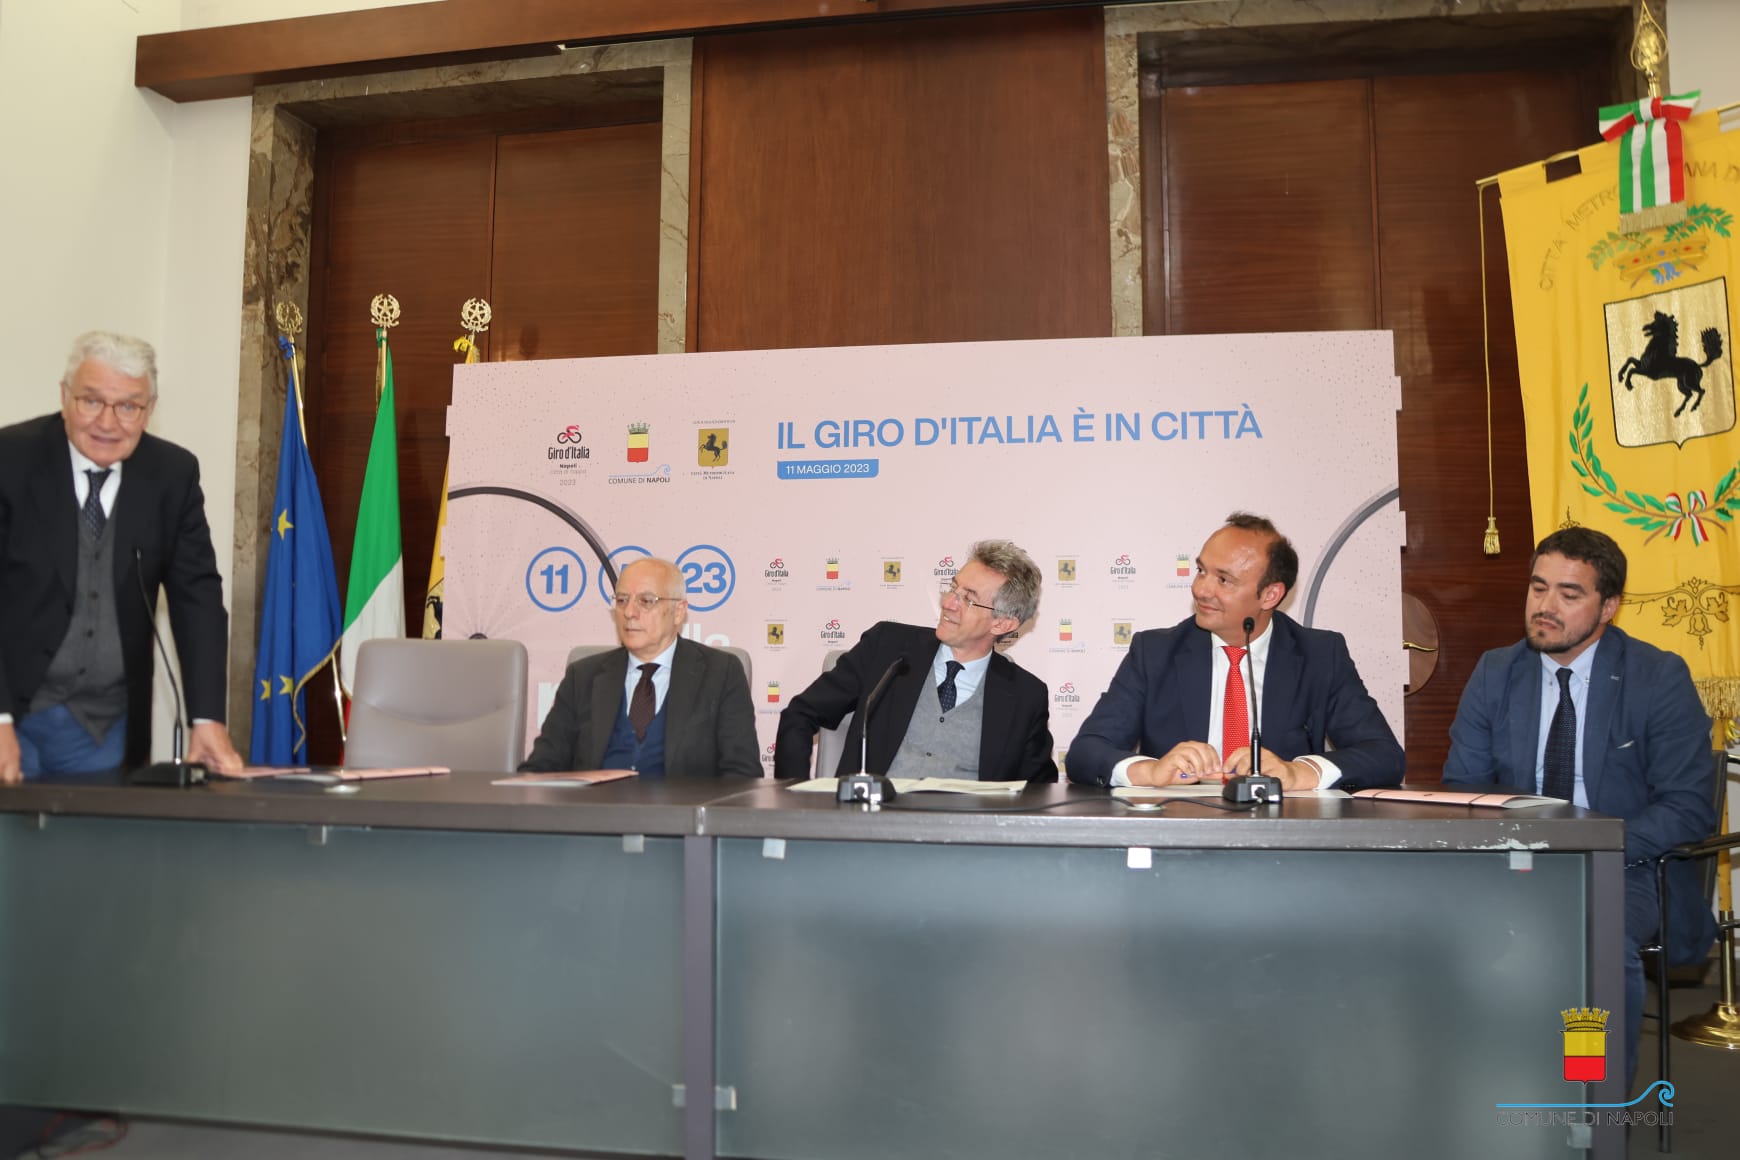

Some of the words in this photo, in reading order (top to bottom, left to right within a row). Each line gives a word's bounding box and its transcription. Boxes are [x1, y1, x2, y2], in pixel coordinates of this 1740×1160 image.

[777, 422, 805, 450] IL
[814, 418, 905, 449] GIRO
[914, 414, 1063, 446] D'ITALIA
[1073, 406, 1095, 442] È
[1105, 412, 1141, 441] IN
[1151, 403, 1263, 441] CITTÀ
[548, 447, 564, 460] Giro
[565, 446, 590, 460] d'Italia
[785, 465, 795, 475] 11
[796, 464, 842, 475] MAGGIO
[843, 463, 870, 473] 2023
[608, 477, 637, 485] COMUNE
[646, 476, 671, 484] NAPOLI
[540, 564, 569, 595] 11
[681, 562, 727, 594] 23
